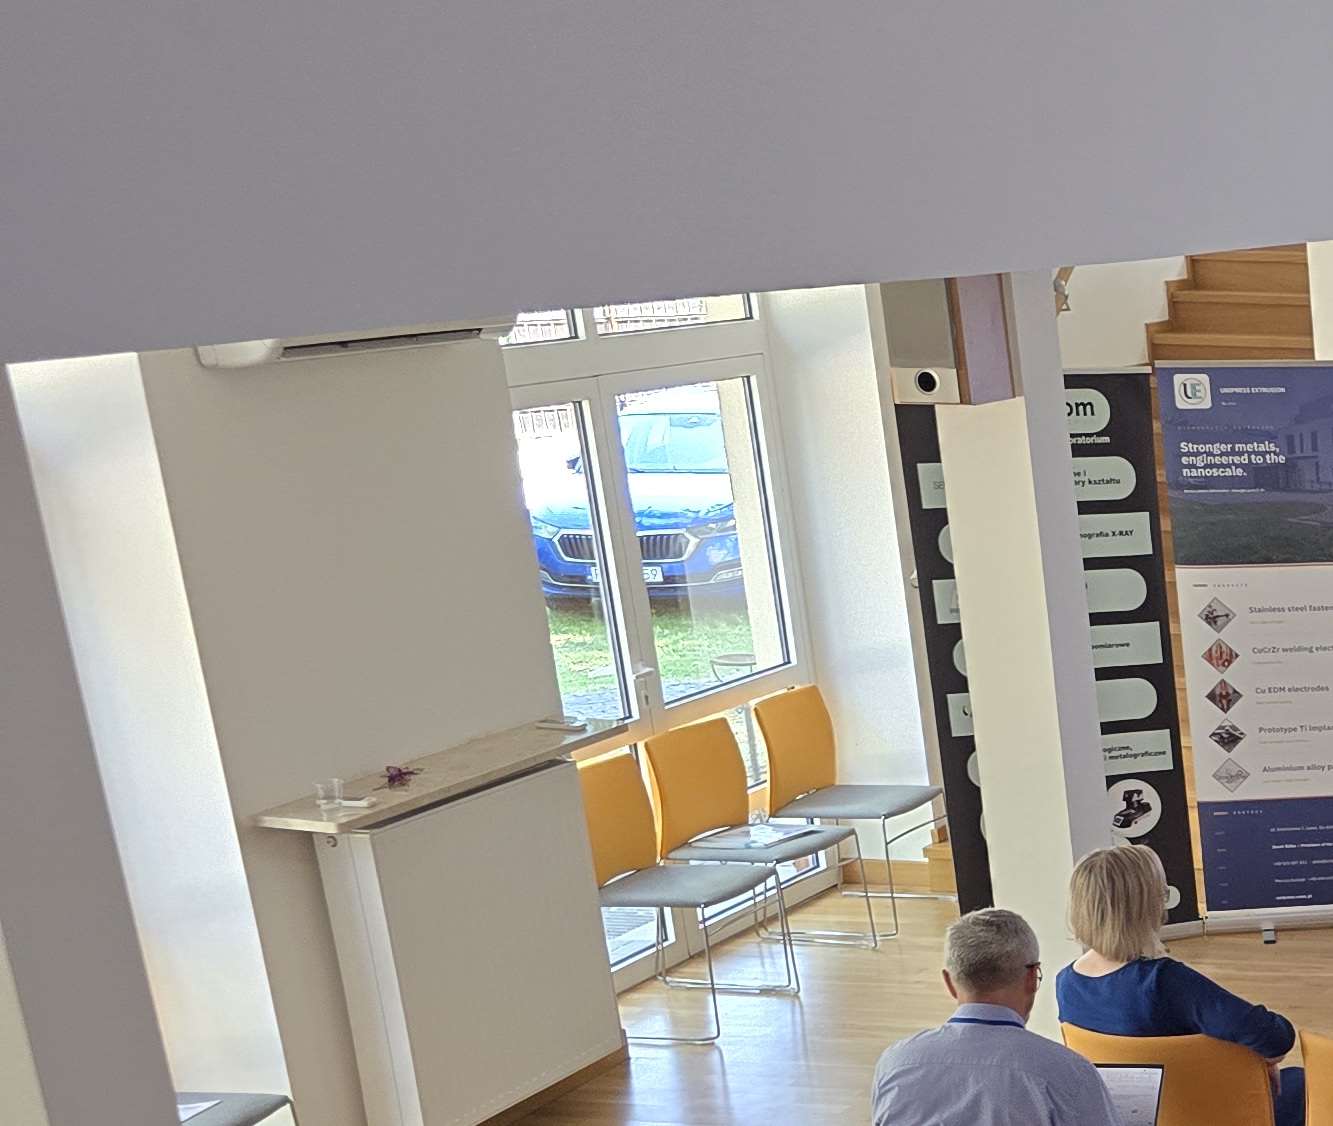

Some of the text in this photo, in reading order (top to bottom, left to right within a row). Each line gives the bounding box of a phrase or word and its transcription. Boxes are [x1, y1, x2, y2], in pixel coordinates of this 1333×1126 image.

[1070, 435, 1110, 444] oratorium
[1180, 441, 1280, 454] Stronger metals,
[1181, 453, 1286, 466] engineered to the
[1182, 465, 1247, 476] nanoscale.
[1111, 529, 1134, 537] X-RAY
[1249, 605, 1286, 614] Stainless
[1287, 605, 1307, 613] steel
[1252, 646, 1280, 654] CuCrZr
[1282, 645, 1314, 654] welding
[1268, 686, 1286, 694] EDM
[1287, 685, 1330, 693] electrodes
[1258, 726, 1298, 735] Prototype
[1108, 750, 1166, 760] metalograficzne
[1262, 765, 1304, 773] Aluminium
[1306, 763, 1325, 772] alloy
